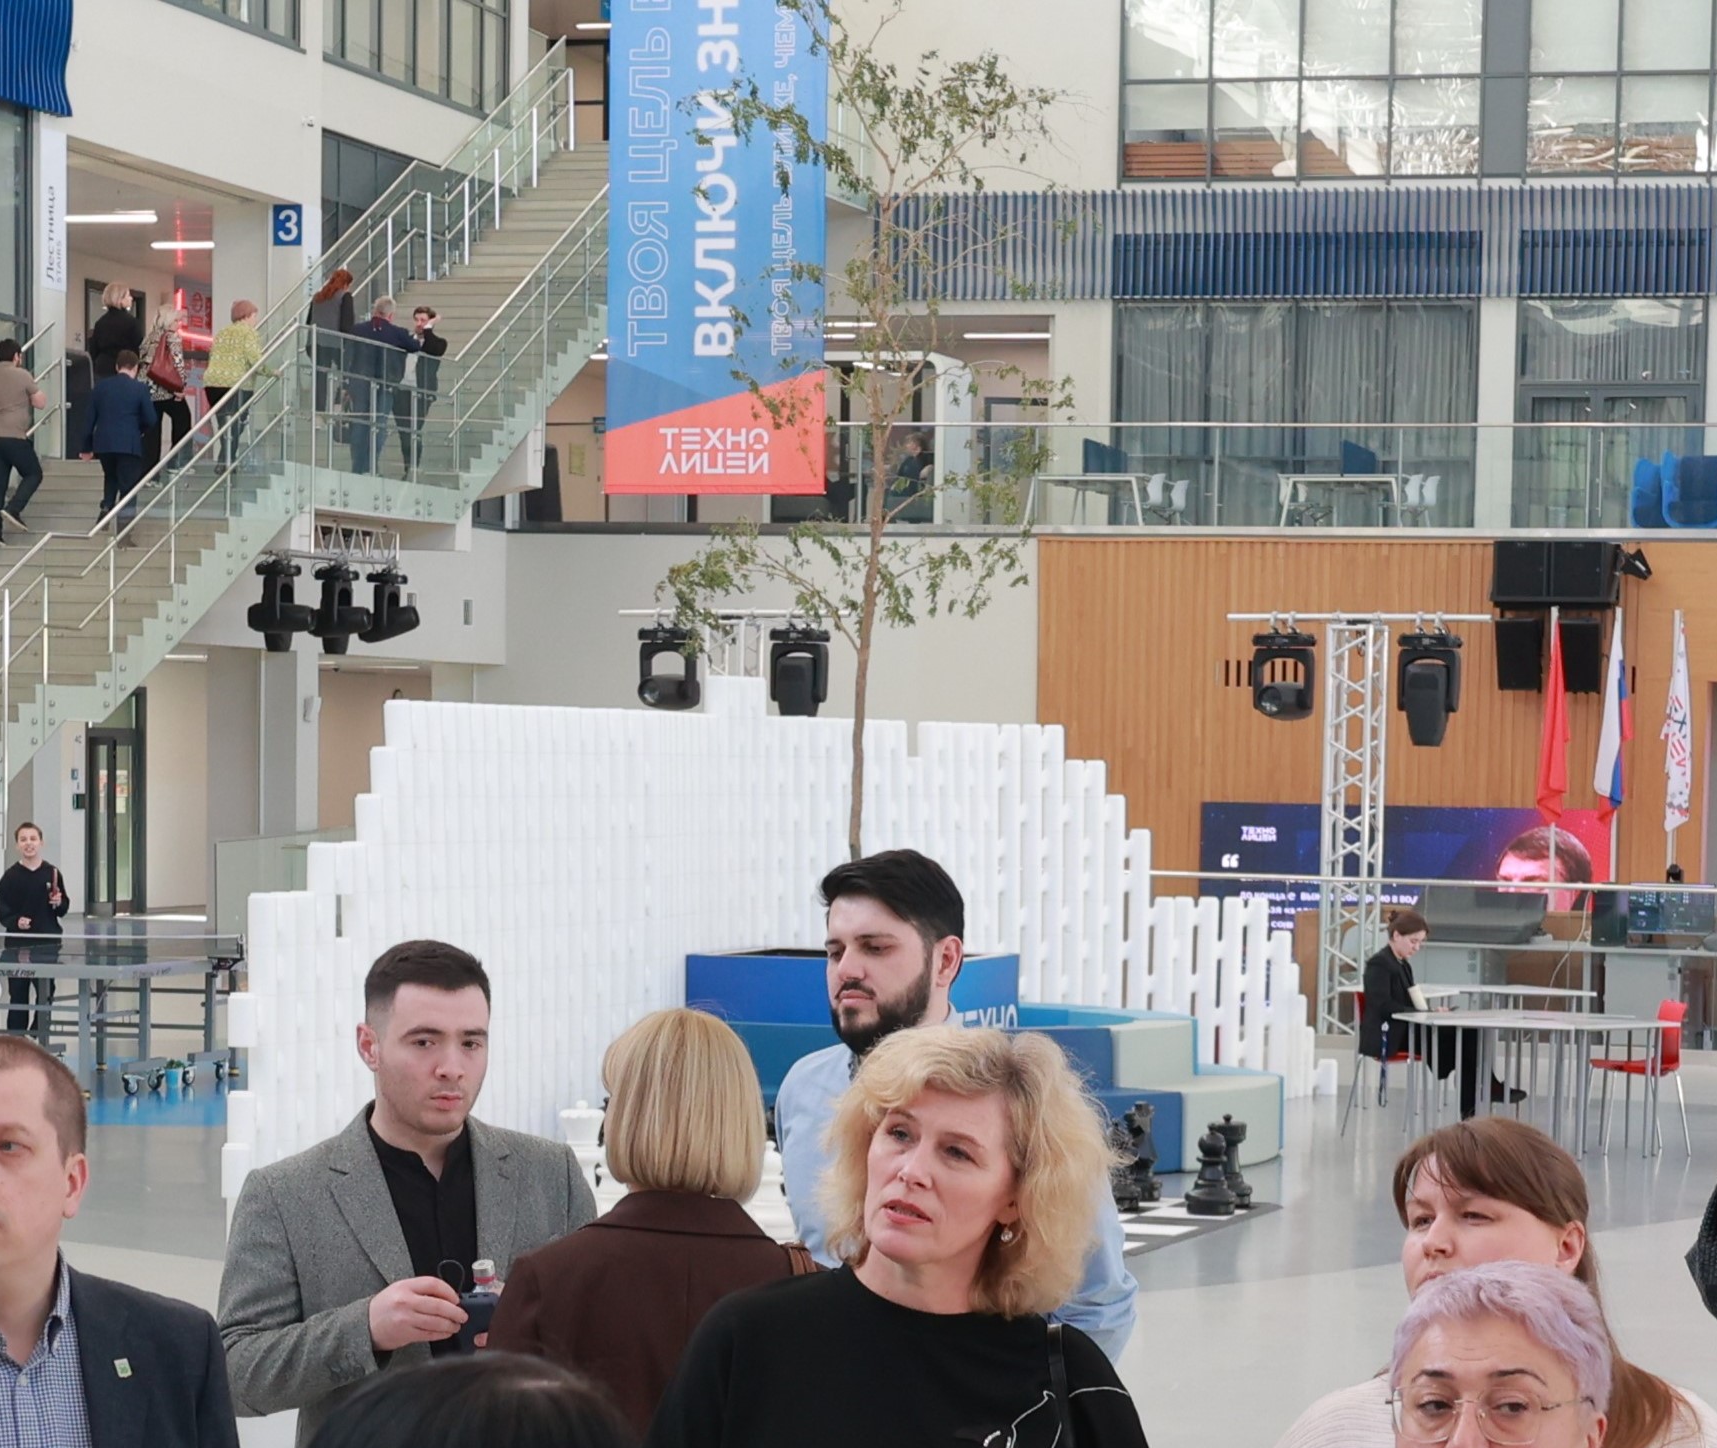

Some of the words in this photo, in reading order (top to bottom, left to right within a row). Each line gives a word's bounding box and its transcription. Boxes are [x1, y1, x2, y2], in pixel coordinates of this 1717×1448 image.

[774, 5, 795, 69] ЧЕМ
[628, 27, 678, 182] ЦЕЛЬ
[46, 186, 55, 282] Лестница
[277, 209, 299, 241] 3
[694, 89, 738, 356] ВКЛЮЧИ
[772, 193, 796, 272] ЦЕЛЬ
[627, 201, 669, 357] ТВОЯ
[771, 278, 793, 356] ТВОЯ
[659, 427, 769, 450] ТЕХНО
[1241, 826, 1277, 834] ТЕХНО
